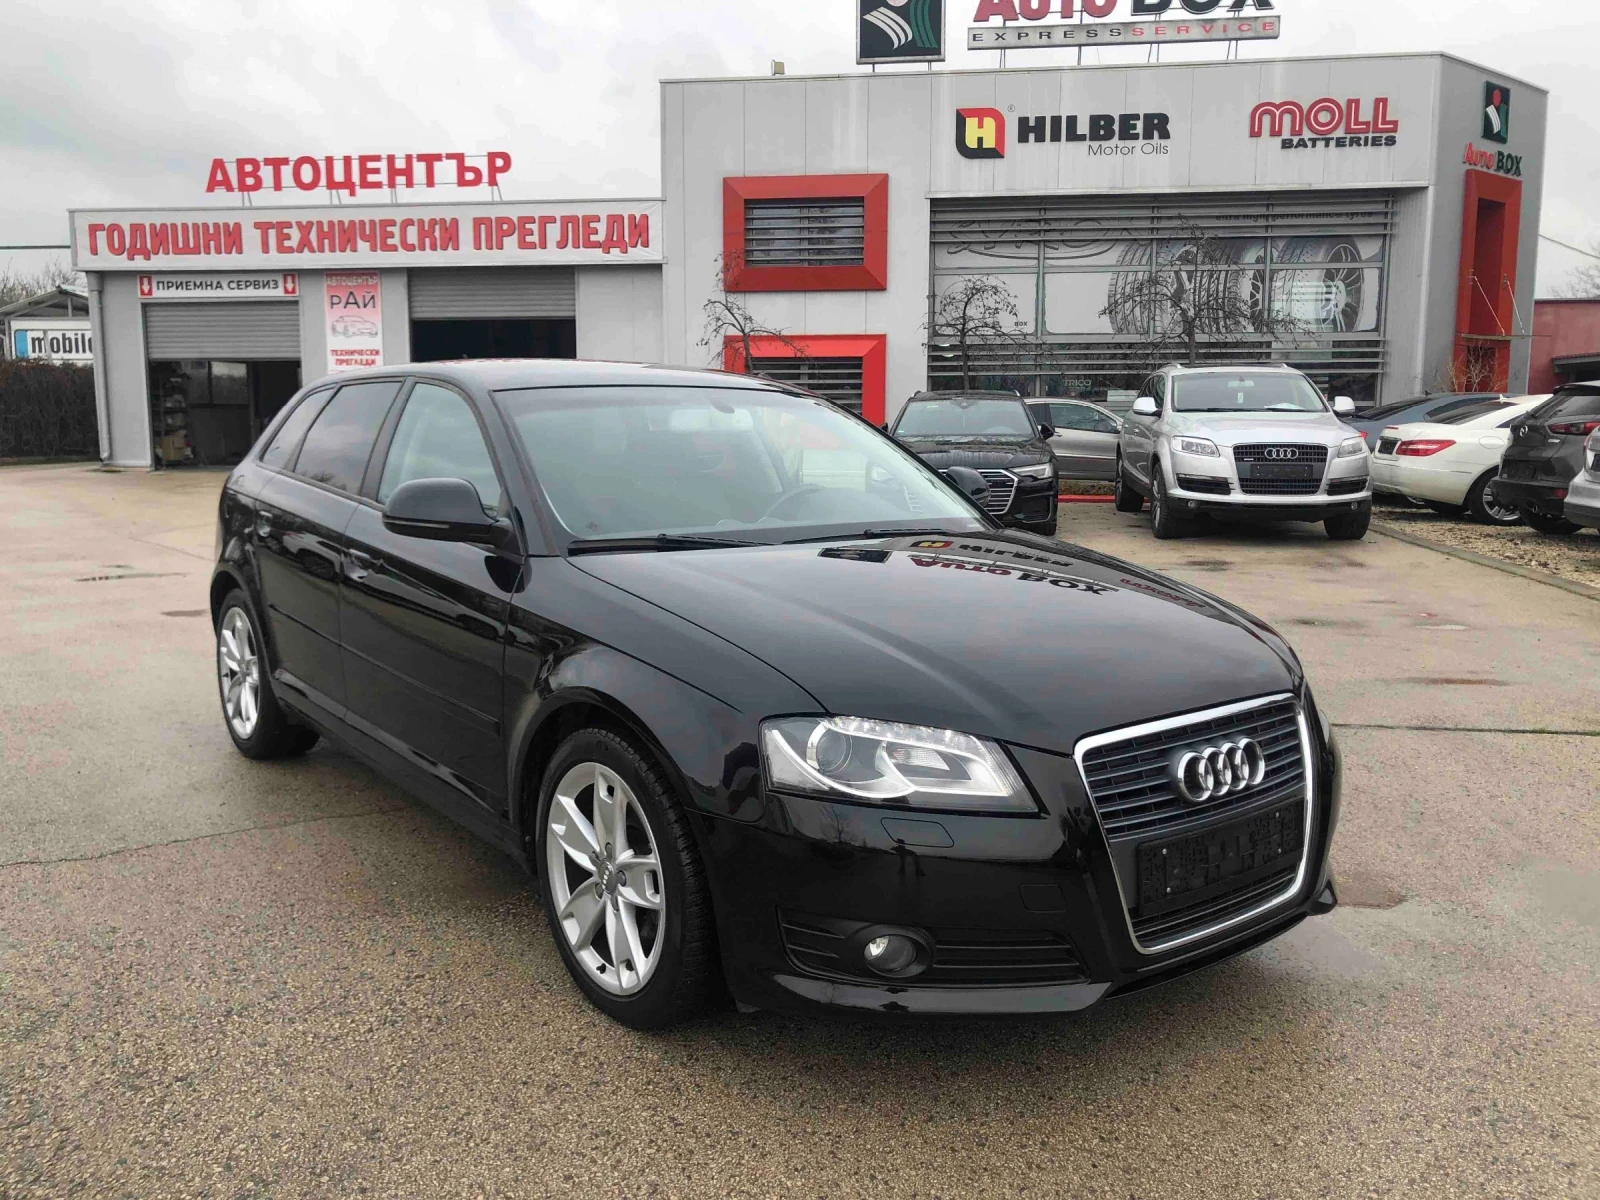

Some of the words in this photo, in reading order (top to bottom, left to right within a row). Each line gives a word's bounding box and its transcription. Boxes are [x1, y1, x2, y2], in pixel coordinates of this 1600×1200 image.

[1017, 112, 1171, 143] HILBER
[1249, 97, 1399, 138] MOLL
[1088, 144, 1136, 156] Motor
[1141, 142, 1169, 155] Oils
[1281, 135, 1398, 149] BATTERIES
[205, 151, 512, 196] АВТОЦЕНТЪР
[1495, 150, 1522, 177] BOX
[88, 222, 243, 261] ГОДИШНИ
[254, 217, 460, 254] ТЕХНИЧЕСКИ
[473, 213, 649, 254] ПРЕГЛЕДИ
[156, 280, 224, 291] ПРИЕМНА
[227, 279, 279, 290] СЕРВИЗ
[330, 290, 376, 309] РАЙ
[1063, 379, 1092, 387] TRICO
